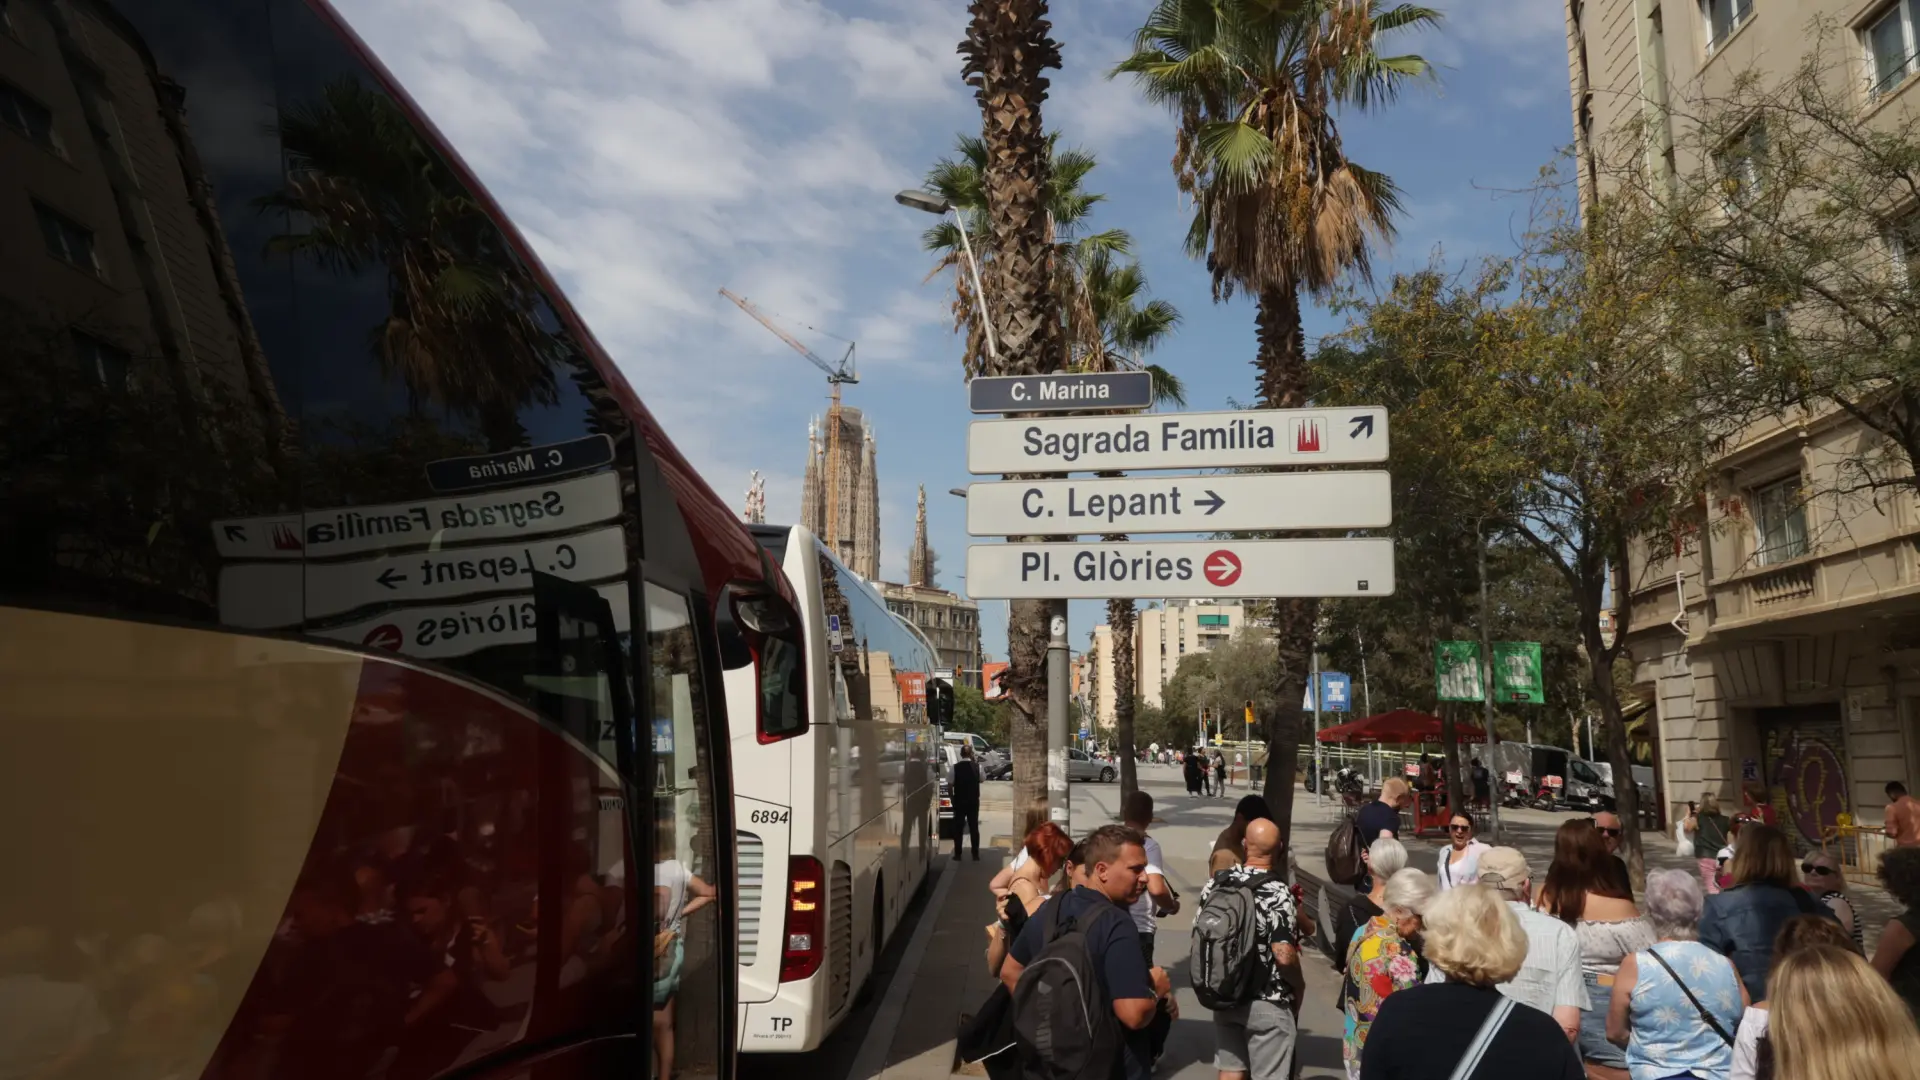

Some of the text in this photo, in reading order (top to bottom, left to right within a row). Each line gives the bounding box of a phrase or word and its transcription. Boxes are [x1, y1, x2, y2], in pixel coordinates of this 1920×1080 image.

[1010, 381, 1110, 402] C. Marina
[1023, 419, 1275, 462] Sagrada Família
[1022, 486, 1181, 523] C. Lepant
[1021, 550, 1193, 582] Pl. Glòries
[751, 809, 789, 824] 6894
[770, 1016, 793, 1032] TP
